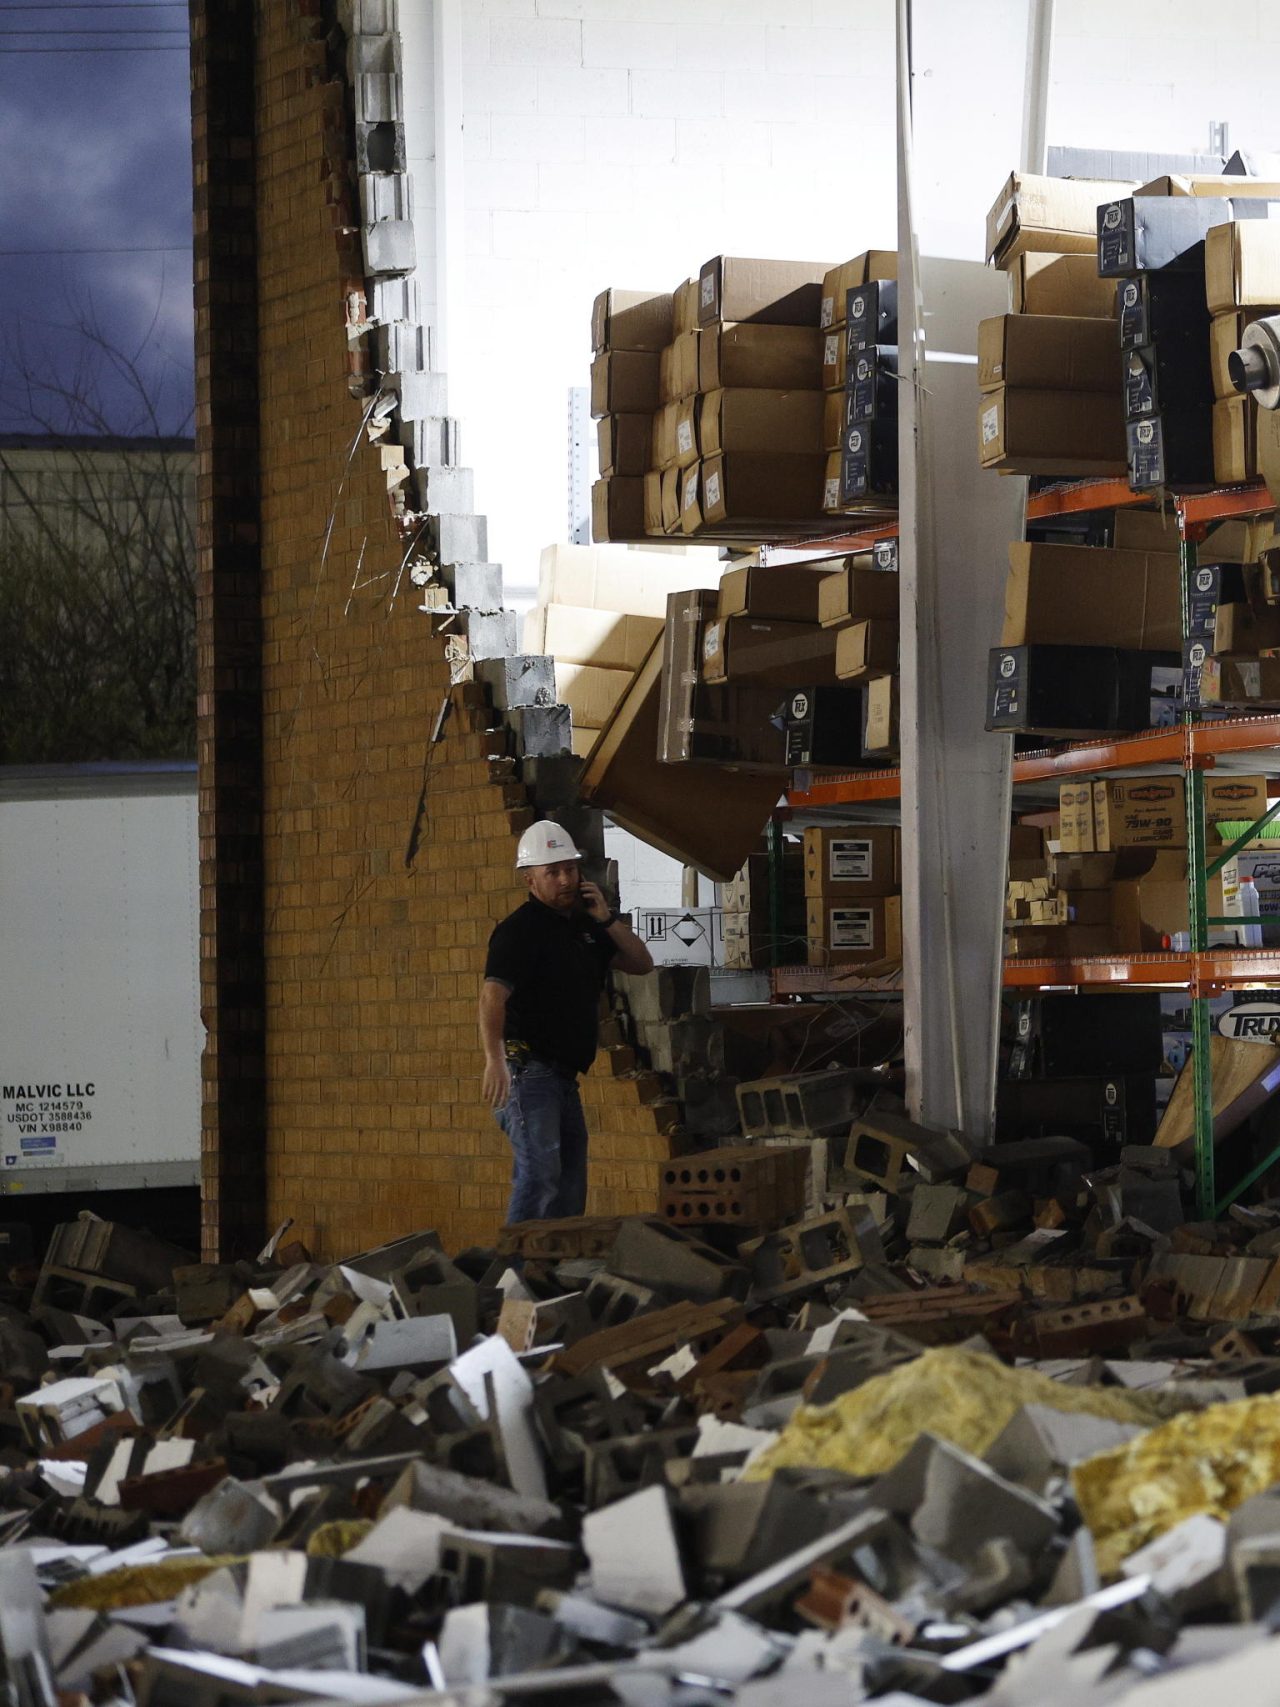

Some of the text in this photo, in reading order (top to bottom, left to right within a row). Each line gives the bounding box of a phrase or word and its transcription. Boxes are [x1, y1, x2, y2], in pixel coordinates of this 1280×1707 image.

[794, 699, 807, 714] TRUX
[3, 1083, 95, 1099] MALVIC LLC
[16, 1101, 83, 1112] MC 1214579
[8, 1111, 92, 1123] USDOT 3588436
[19, 1122, 82, 1132] VIN X98840
